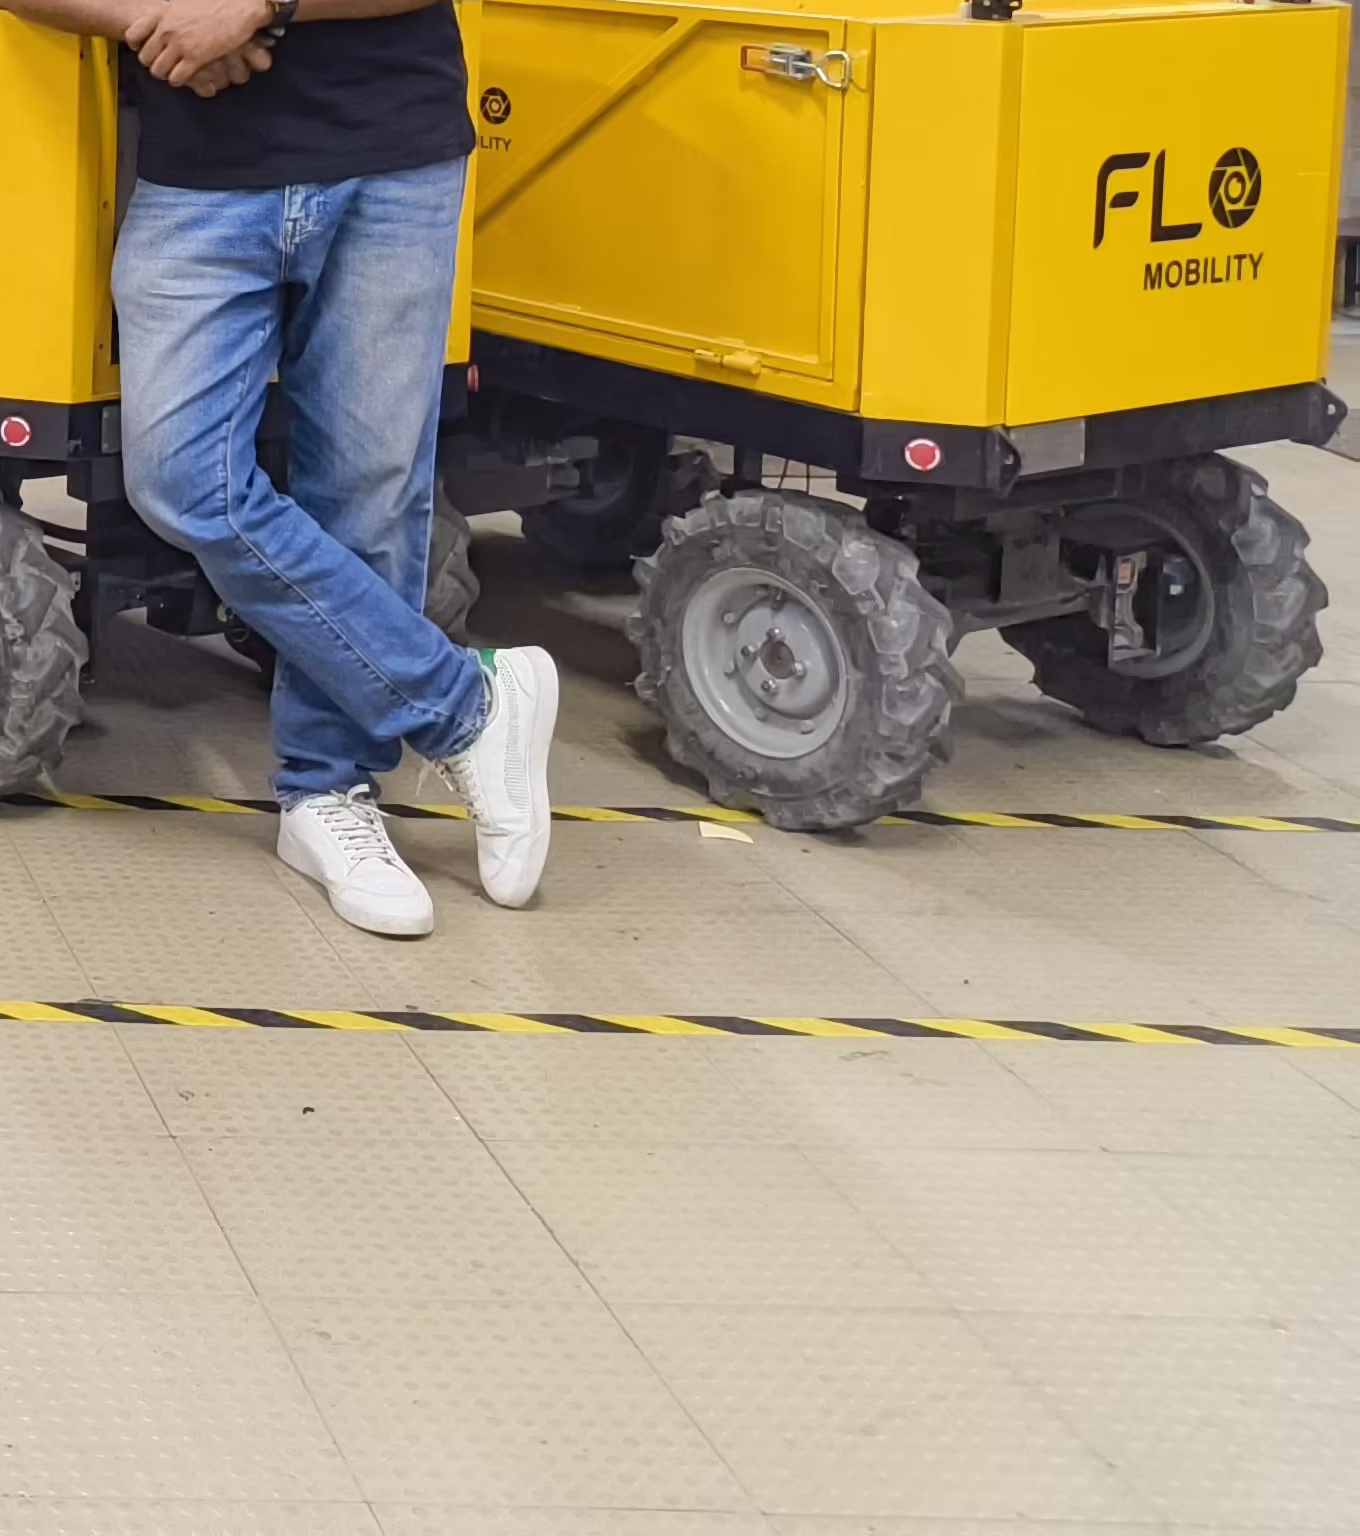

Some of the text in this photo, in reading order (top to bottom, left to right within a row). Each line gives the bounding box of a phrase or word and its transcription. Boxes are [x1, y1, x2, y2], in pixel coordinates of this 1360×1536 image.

[480, 135, 512, 153] LITY
[1092, 146, 1263, 250] FLO
[1142, 251, 1265, 291] MOBILITY
